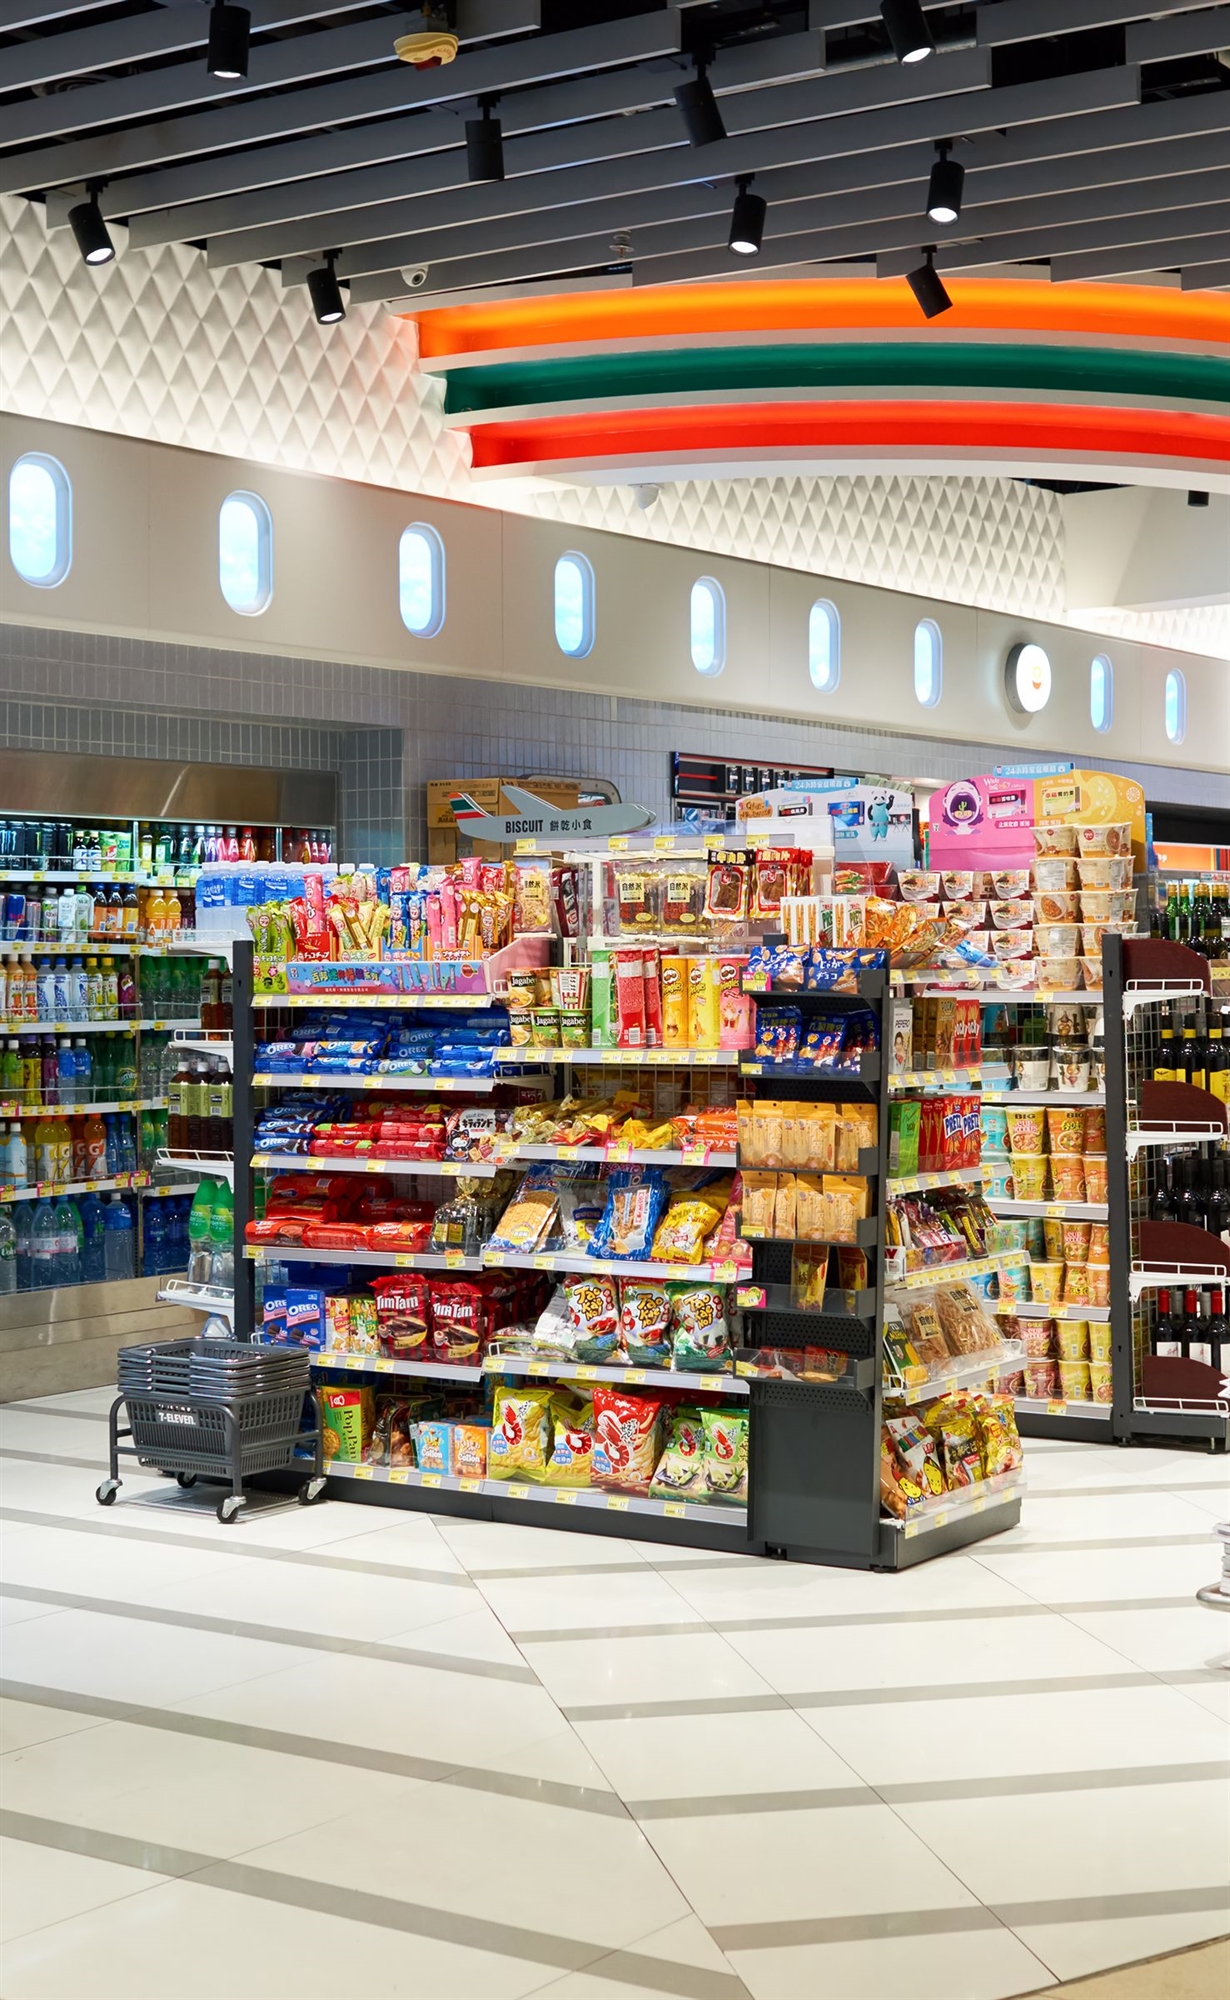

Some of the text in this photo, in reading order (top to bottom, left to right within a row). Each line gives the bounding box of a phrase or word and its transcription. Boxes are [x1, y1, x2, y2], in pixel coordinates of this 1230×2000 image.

[505, 818, 592, 834] BISCUIT 餅乾小食
[409, 1031, 434, 1042] OREO
[266, 1042, 297, 1055] OREO
[398, 1045, 427, 1058] OREO
[388, 1060, 416, 1071] OREO
[259, 1138, 290, 1149] OREO
[574, 1286, 601, 1304] Tao
[636, 1293, 663, 1310] Tao
[288, 1303, 319, 1317] OREO
[683, 1294, 710, 1312] Tao
[343, 1410, 358, 1460] Pop Pan
